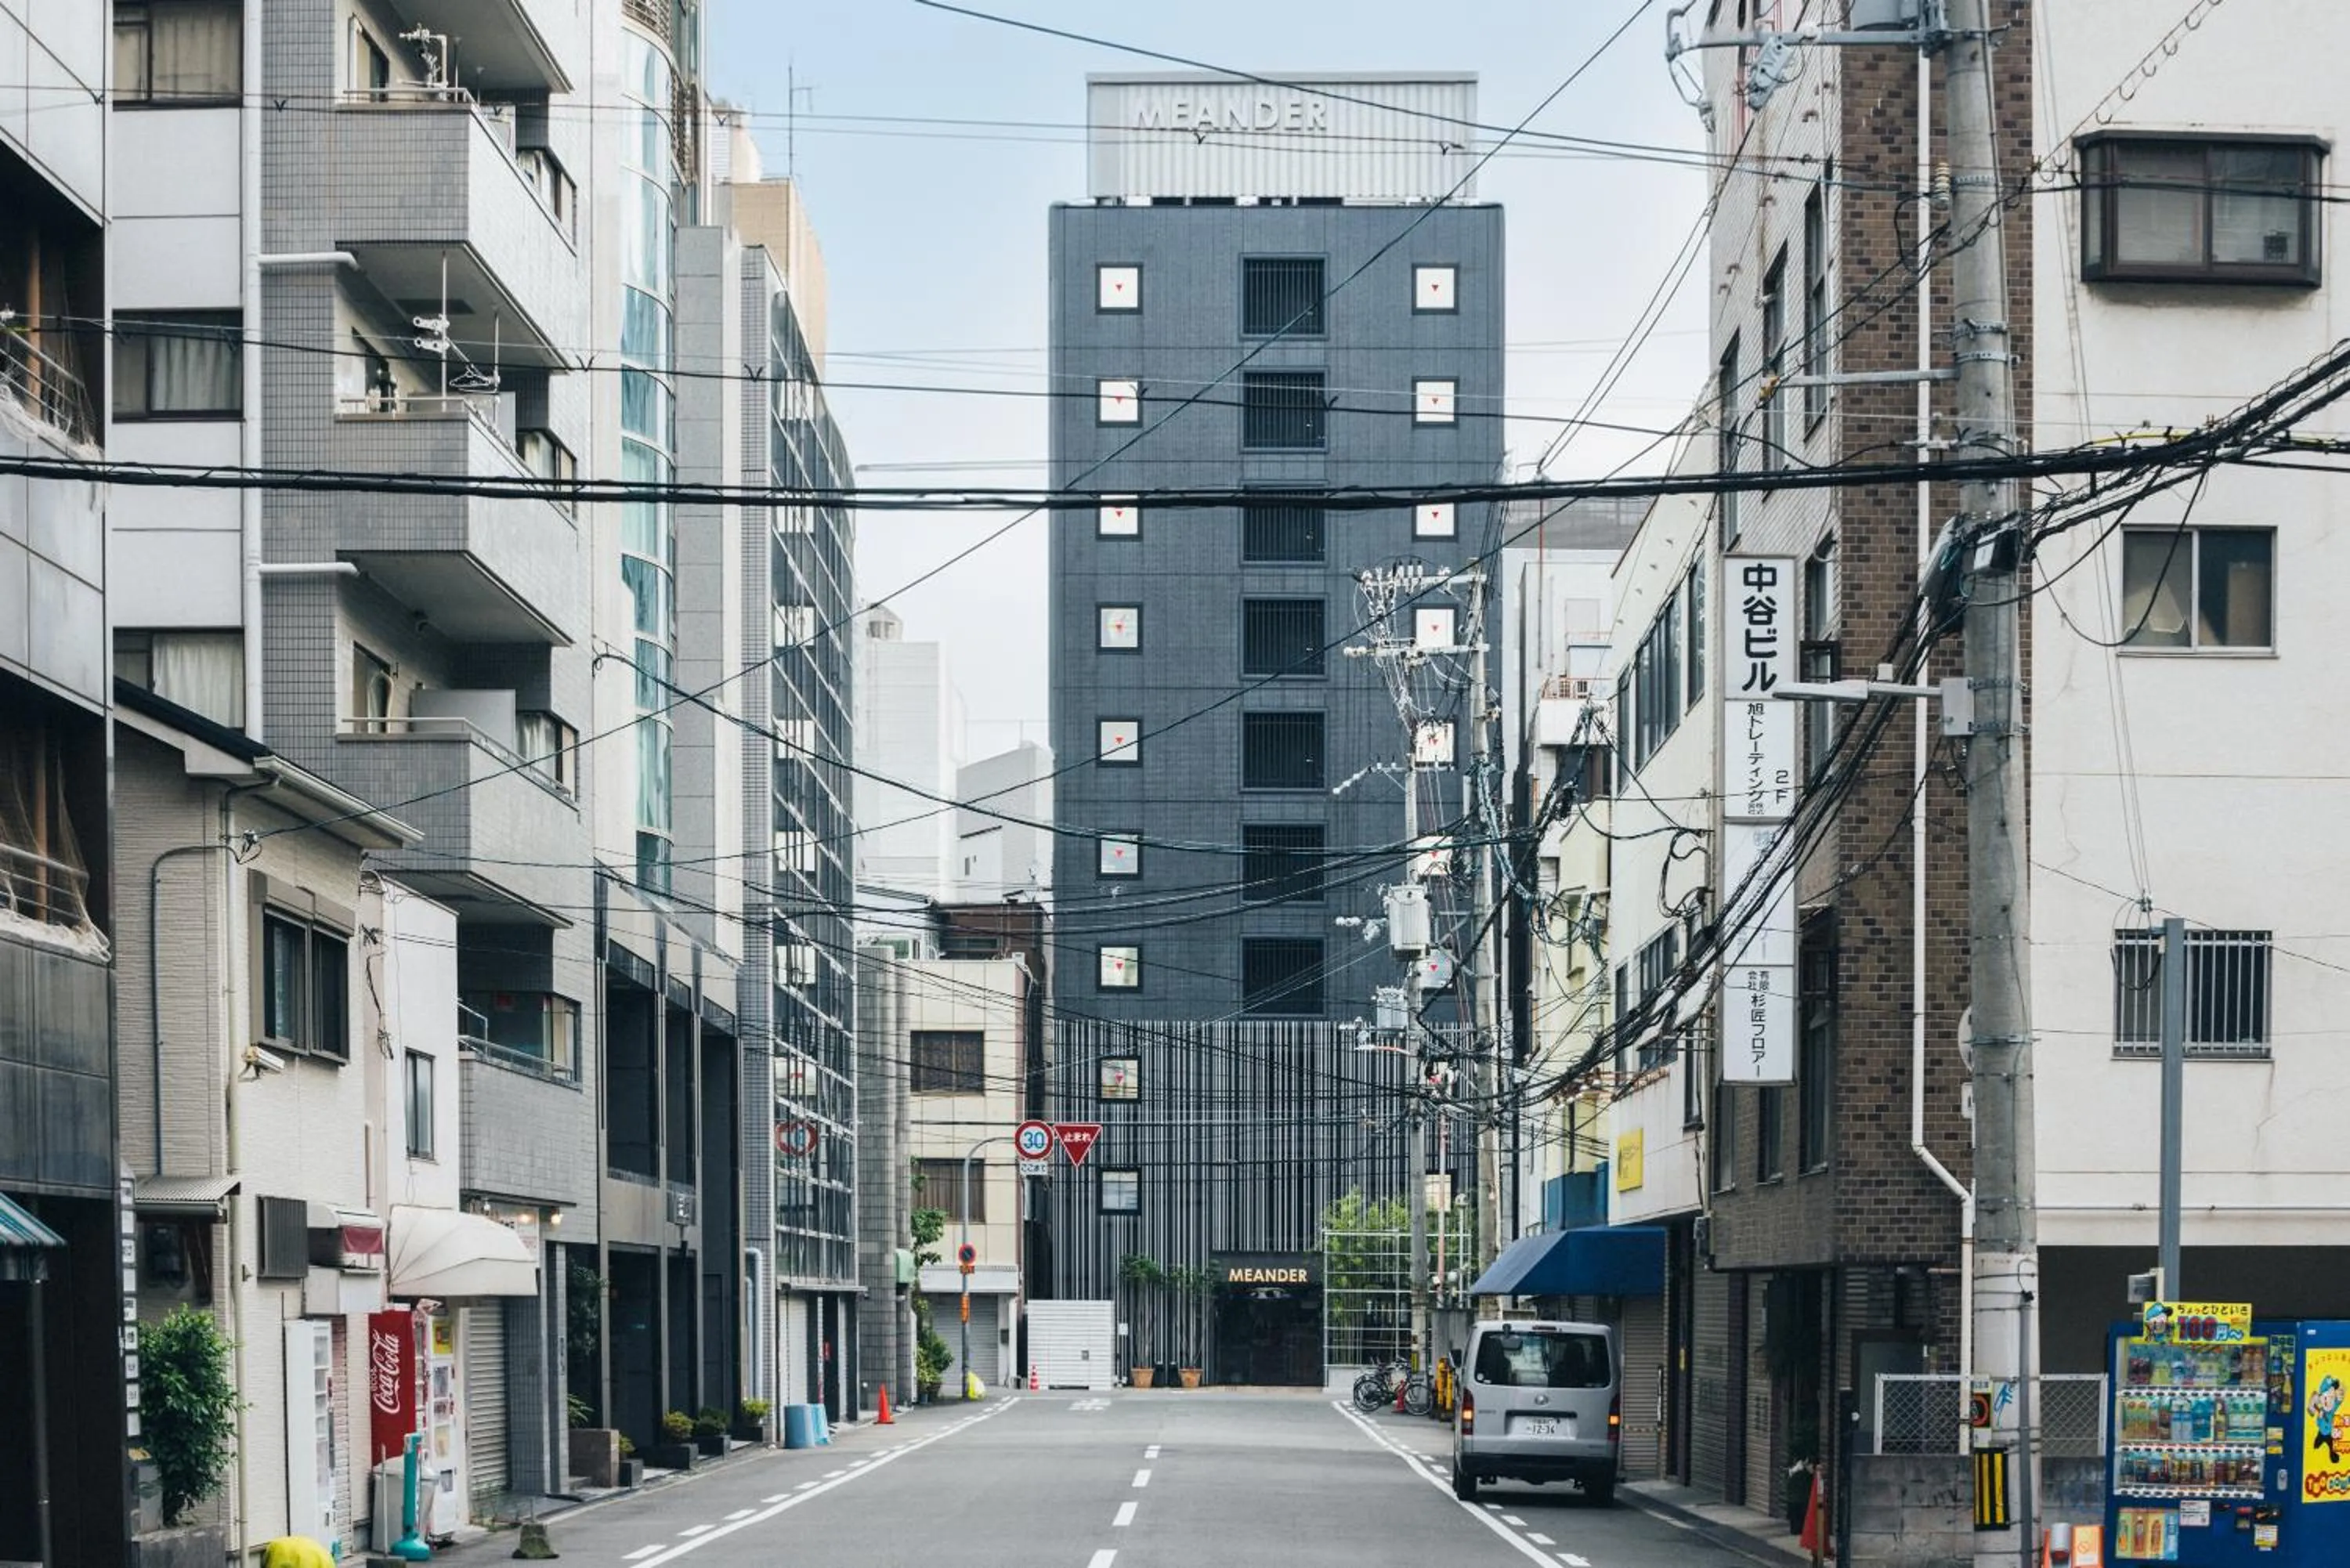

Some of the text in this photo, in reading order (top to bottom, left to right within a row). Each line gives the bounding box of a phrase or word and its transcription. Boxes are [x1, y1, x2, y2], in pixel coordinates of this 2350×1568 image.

[1131, 97, 1329, 132] MEANDER
[1741, 563, 1777, 693] 中谷ビル
[1751, 992, 1766, 1078] 杉匠フロアー
[1024, 1131, 1044, 1148] 30
[1064, 1132, 1090, 1142] 止まれ
[1021, 1162, 1047, 1172] ここまで
[1228, 1268, 1308, 1282] MEANDER
[2178, 1304, 2249, 1316] ちょっとひといき
